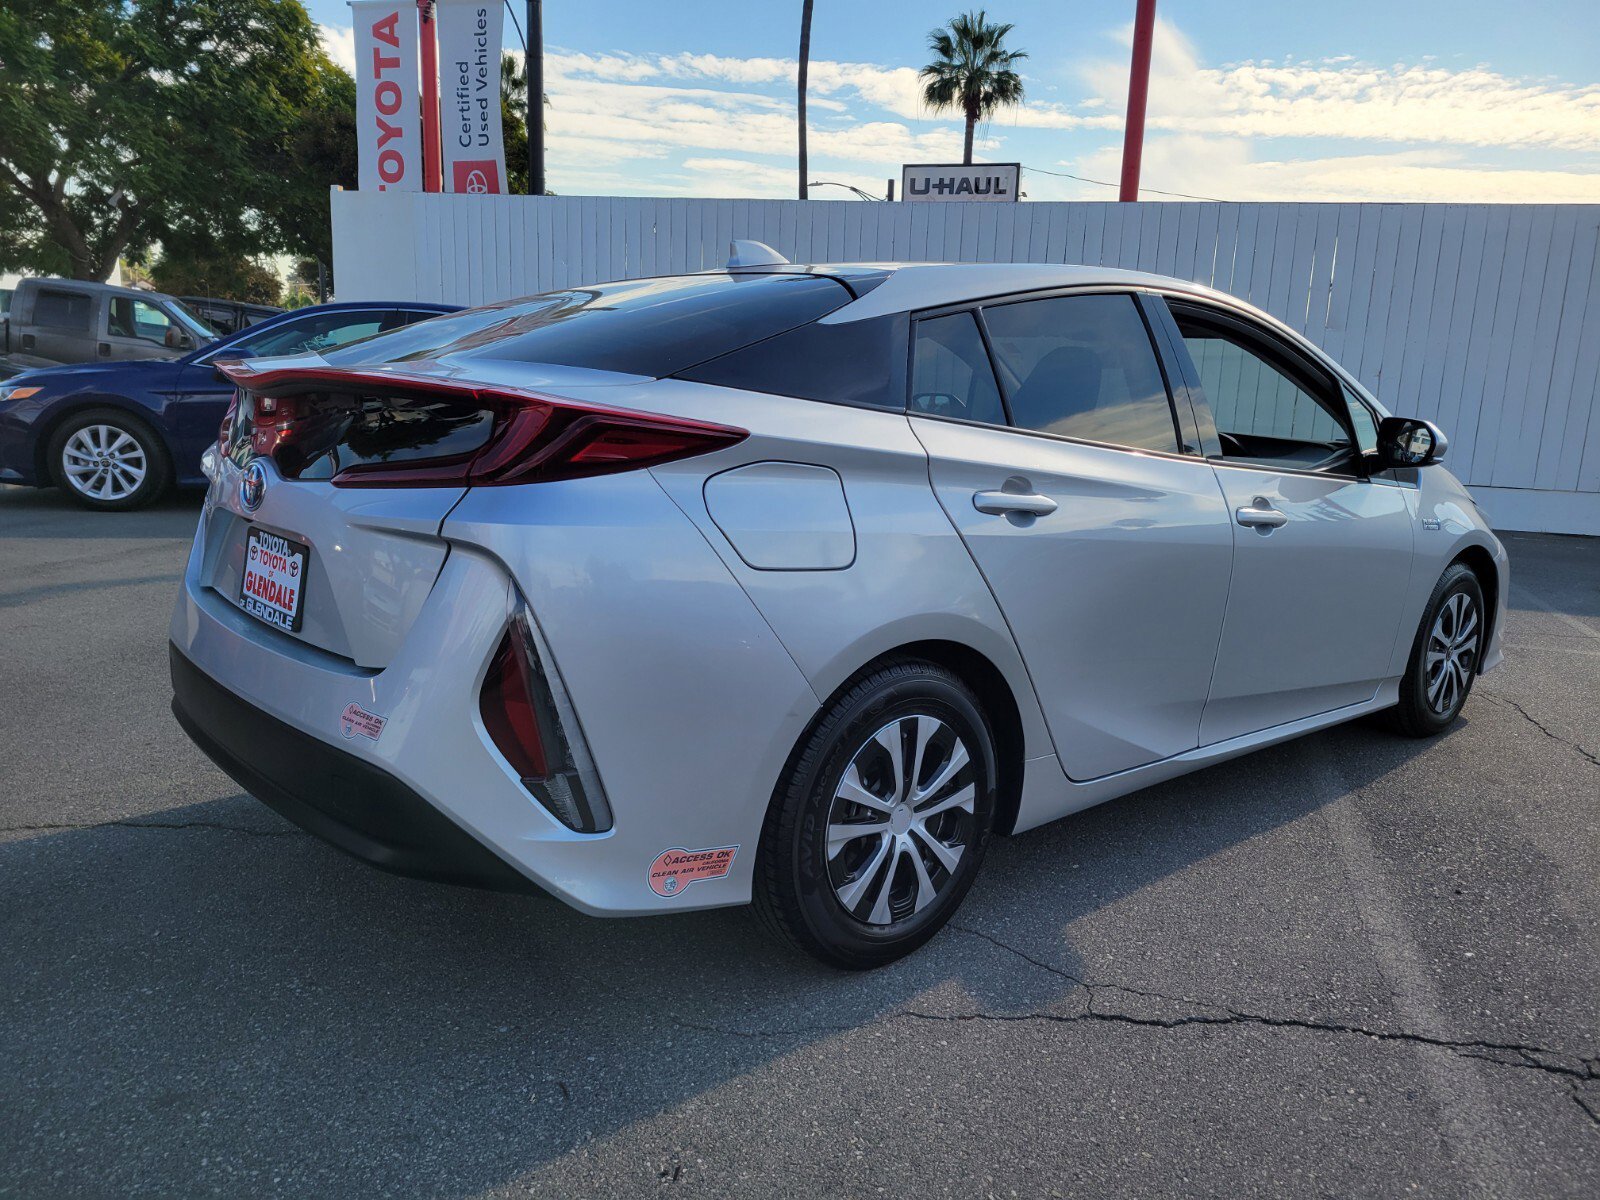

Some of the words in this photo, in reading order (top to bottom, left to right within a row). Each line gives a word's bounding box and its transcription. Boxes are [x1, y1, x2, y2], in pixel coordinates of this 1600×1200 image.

[474, 8, 488, 92] Vehicles
[372, 11, 404, 191] OYOTA
[455, 61, 472, 148] Certified
[476, 98, 490, 147] Used
[259, 531, 289, 557] TOYOTA
[260, 549, 287, 574] TOYOTA
[245, 570, 295, 611] GLENDALE
[246, 598, 293, 630] GLENDALE
[342, 715, 355, 723] CLEAN
[362, 724, 380, 733] VEHICLE
[353, 710, 373, 721] ACCESS
[374, 718, 384, 726] OK
[652, 869, 679, 878] CLEAN
[697, 863, 727, 872] VEHICLE
[671, 852, 714, 865] ACCESS
[716, 850, 732, 859] OK
